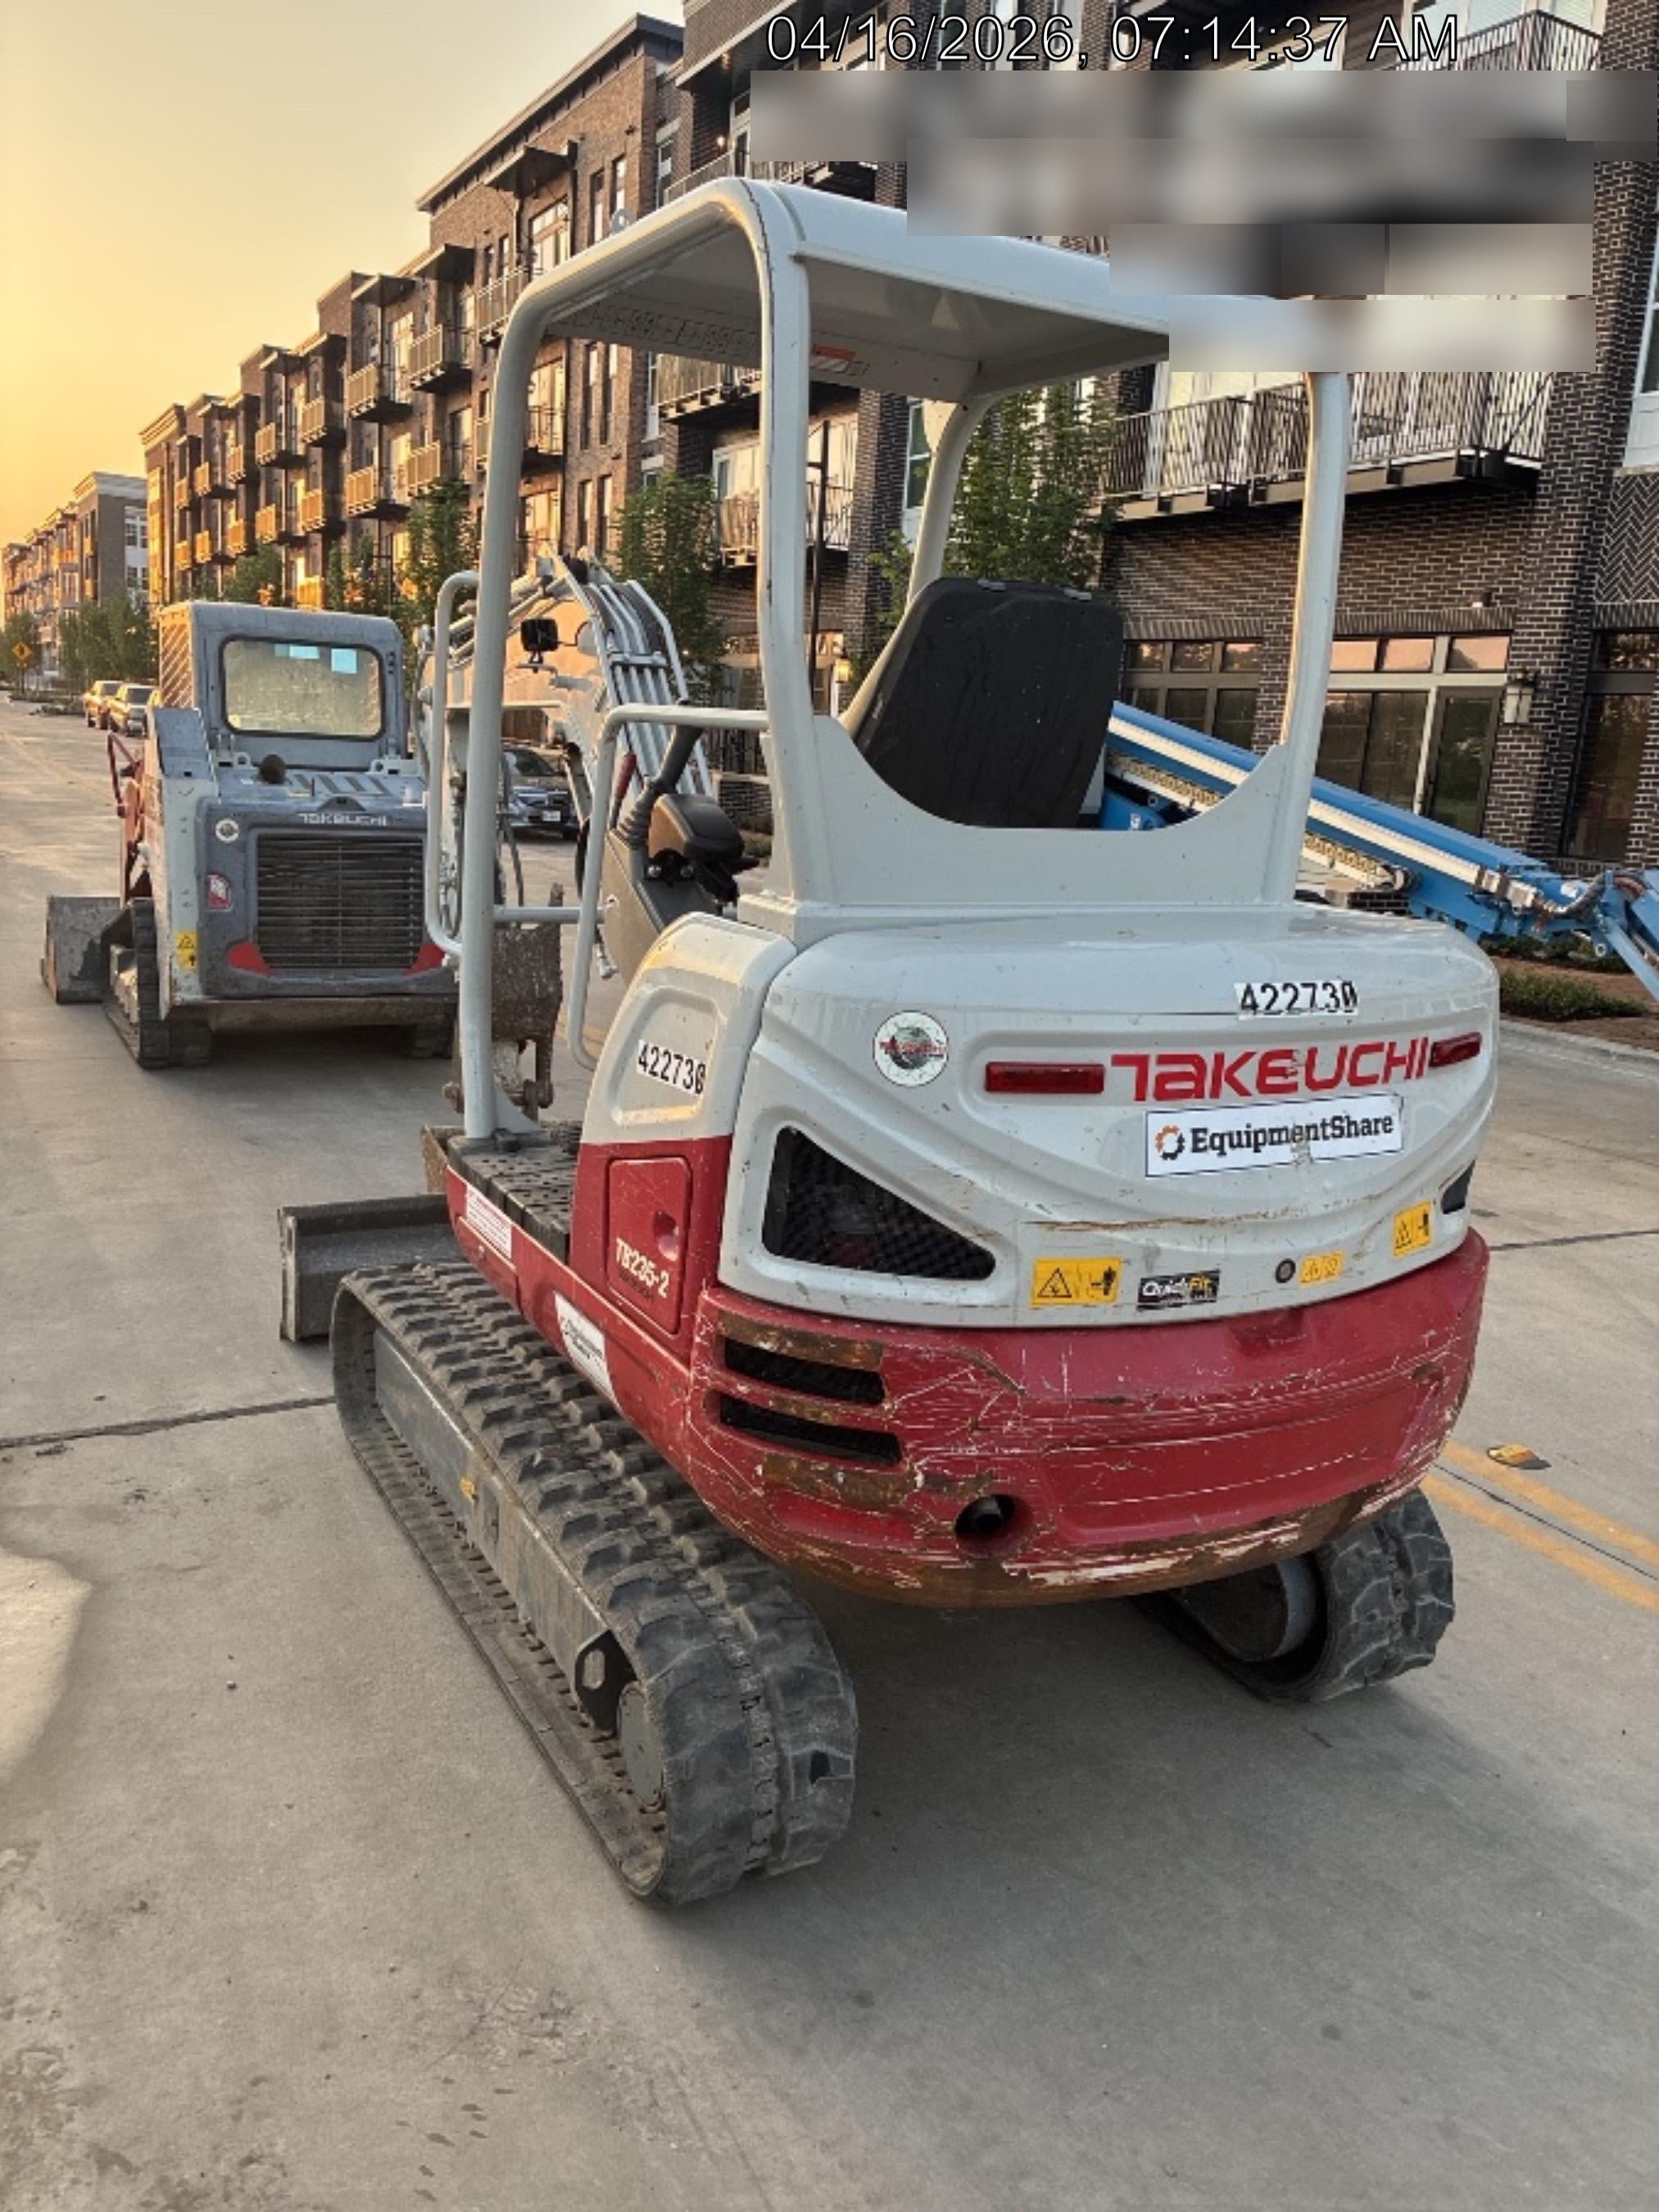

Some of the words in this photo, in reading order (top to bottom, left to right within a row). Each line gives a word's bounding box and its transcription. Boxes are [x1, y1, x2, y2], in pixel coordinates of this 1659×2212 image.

[1240, 980, 1358, 1016] 422730
[1190, 1115, 1394, 1157] EquipmentShare
[615, 1236, 669, 1299] TB235-2
